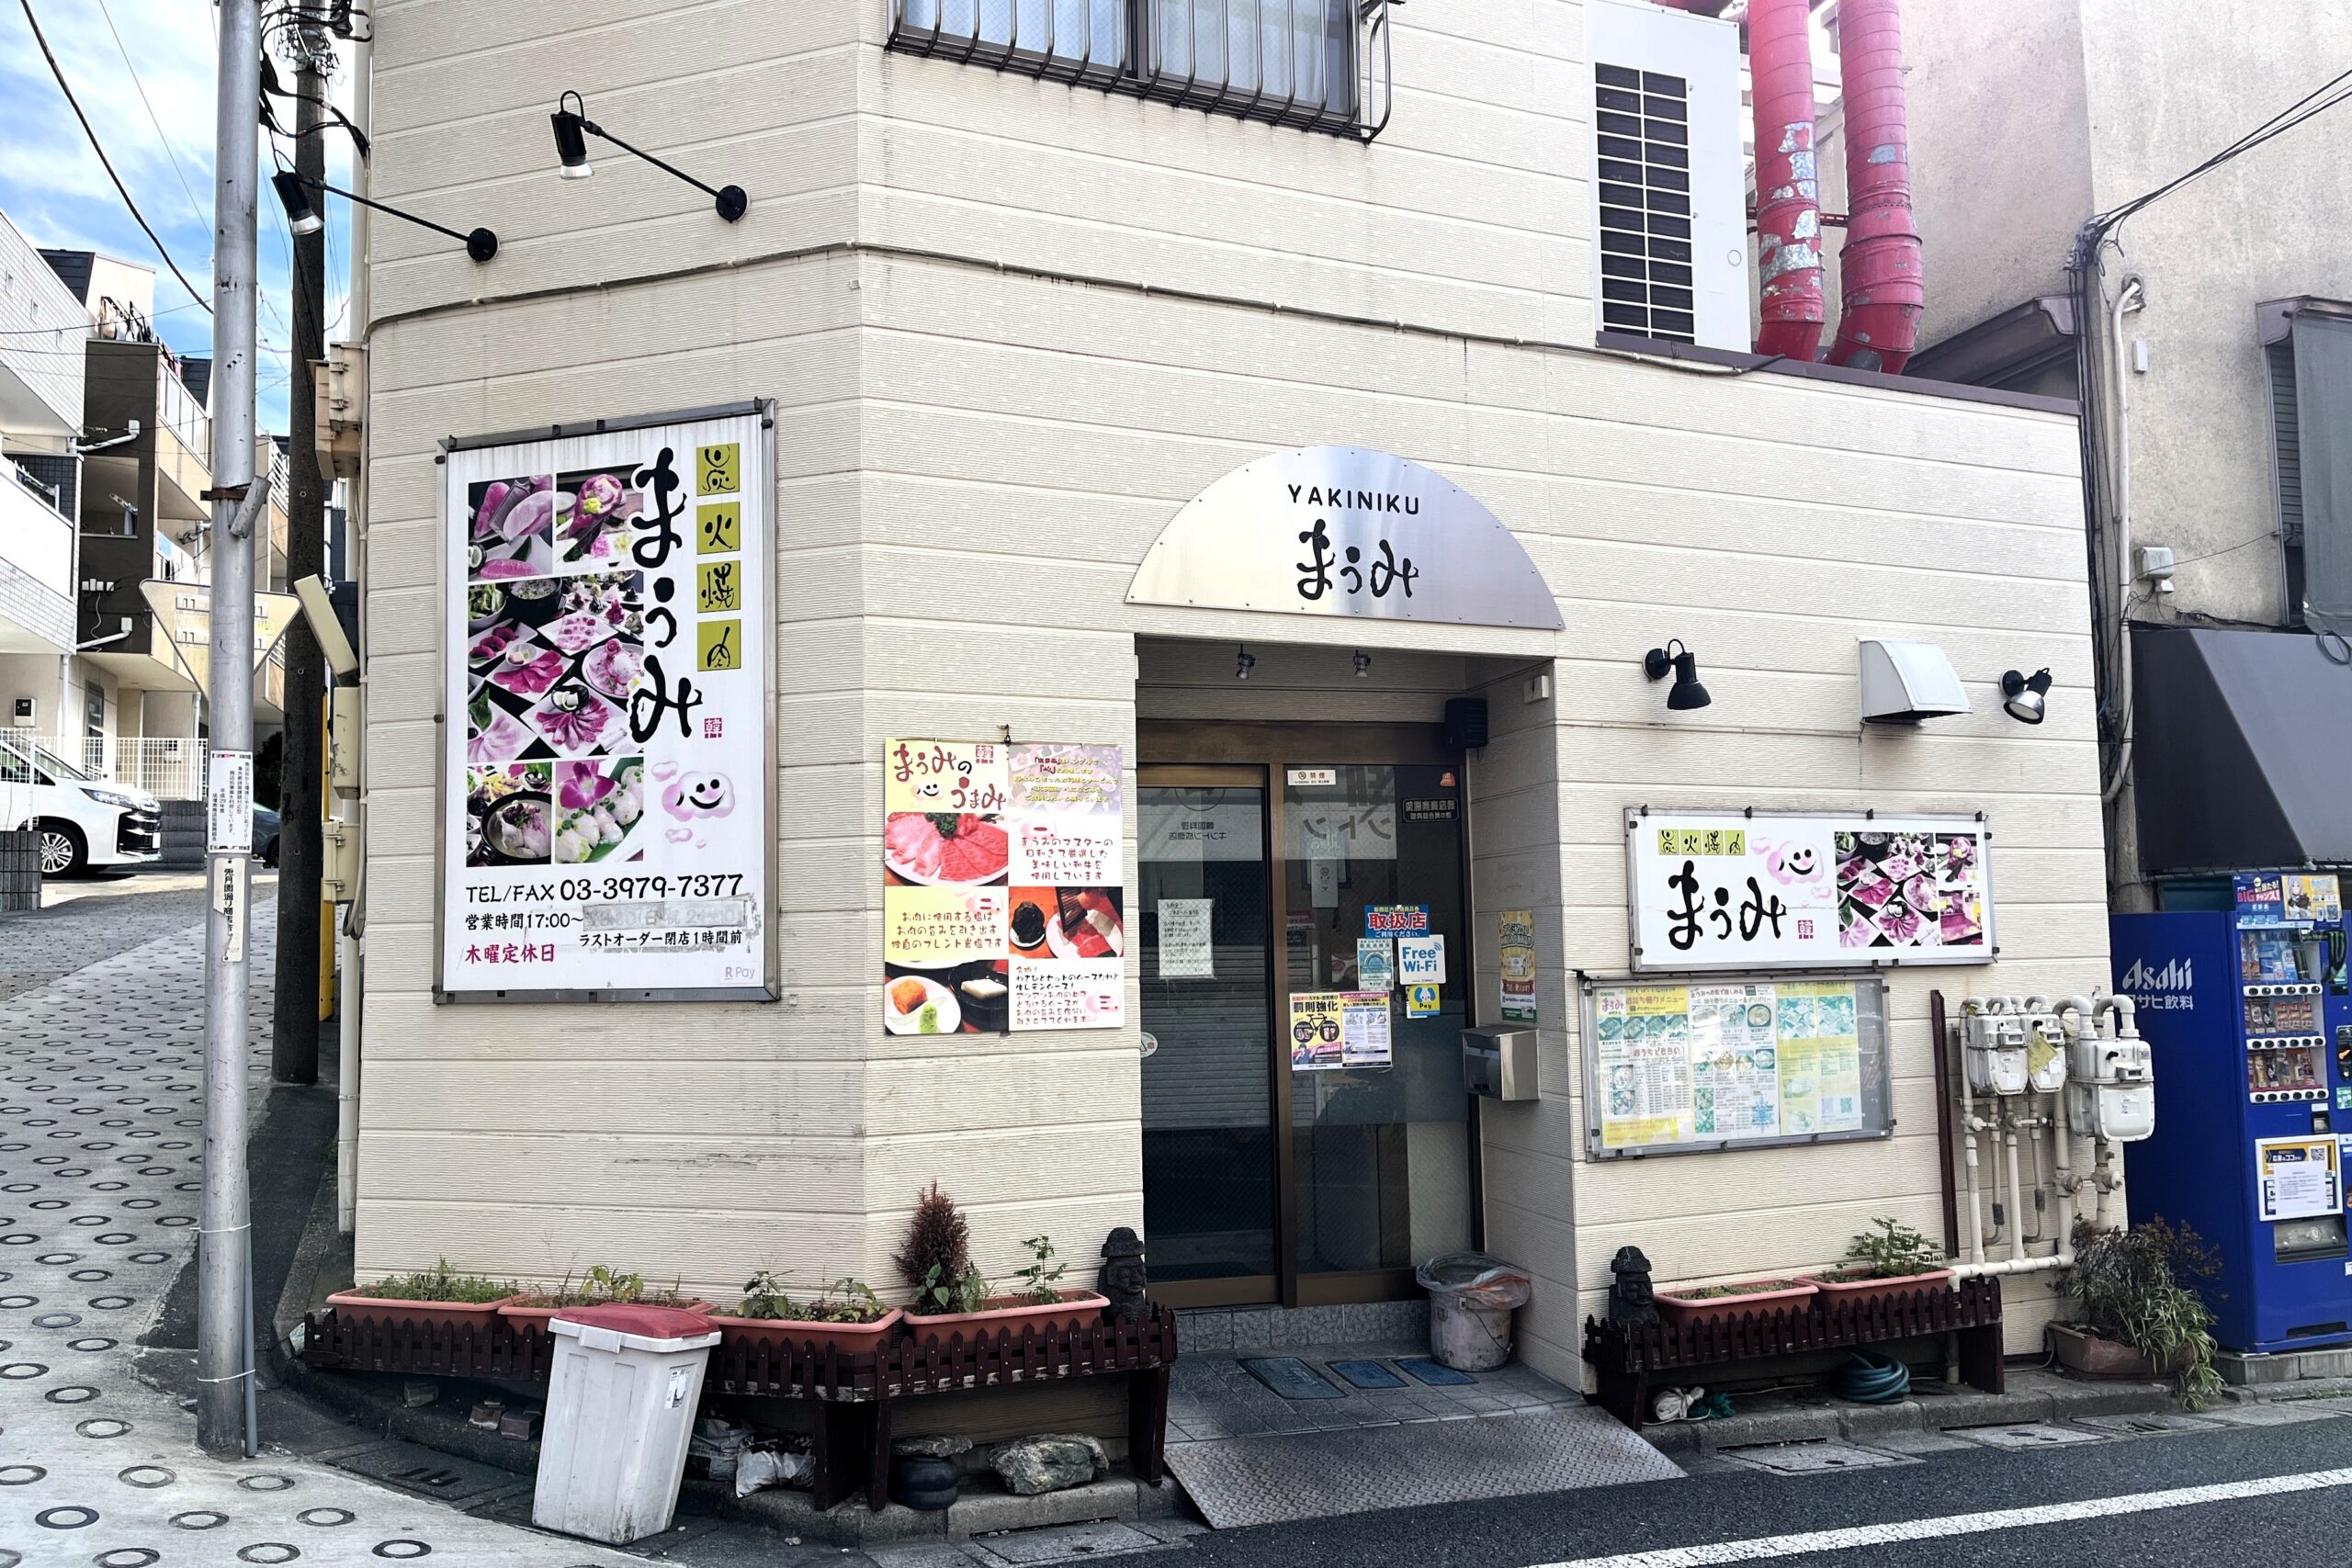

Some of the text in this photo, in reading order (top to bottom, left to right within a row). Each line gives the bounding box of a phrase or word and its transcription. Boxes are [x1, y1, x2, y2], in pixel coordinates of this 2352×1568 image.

[1287, 483, 1419, 515] YAKINIKU
[1295, 519, 1419, 601] まうみ
[627, 446, 703, 744] まうみ
[465, 874, 744, 903] TEL/FAX 03-3979-7377
[1667, 860, 1787, 951] まうみ
[1368, 912, 1427, 931] 取扱店
[464, 943, 555, 964] 木曜定休日
[1402, 947, 1436, 960] Free
[735, 966, 755, 979] Pay
[1404, 961, 1437, 973] Wi-Fi
[2122, 958, 2193, 991] Asahi
[1294, 1000, 1339, 1013] 罰則強化
